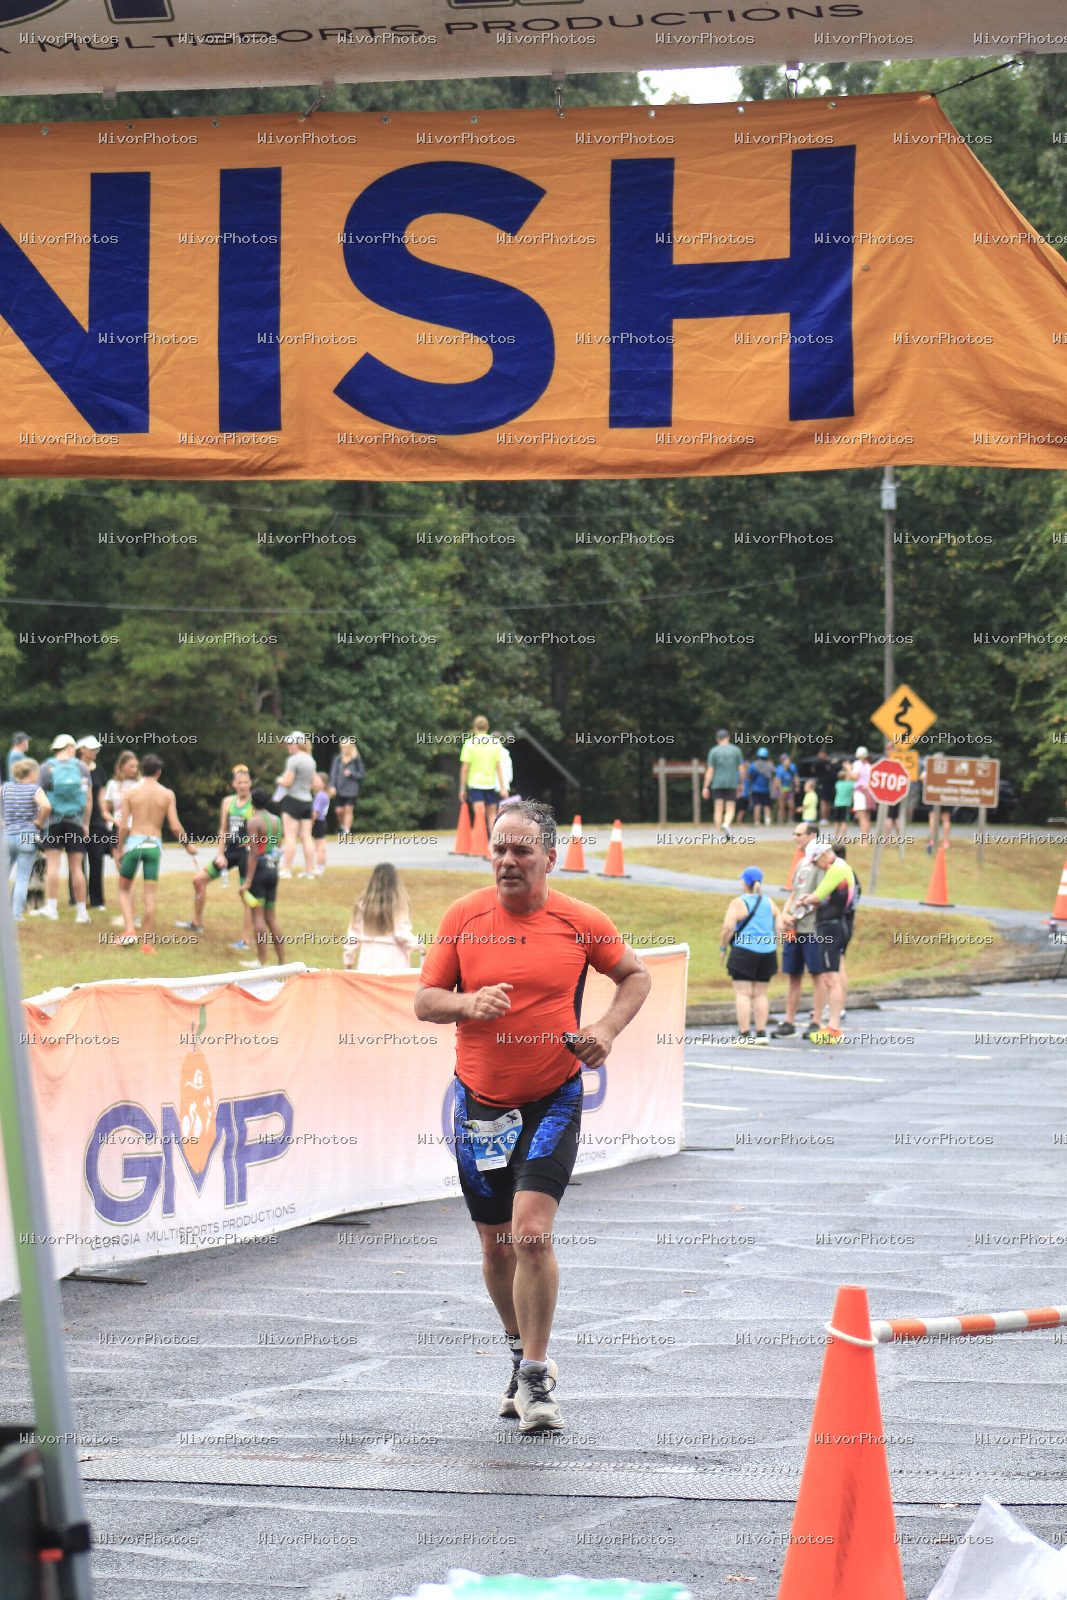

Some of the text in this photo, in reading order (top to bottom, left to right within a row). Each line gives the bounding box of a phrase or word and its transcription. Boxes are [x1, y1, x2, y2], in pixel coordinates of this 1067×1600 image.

[444, 4, 864, 35] PRODUCTIONS
[870, 770, 907, 791] STOP
[85, 1089, 295, 1226] GMP
[146, 1222, 219, 1243] MULTISPORTS
[222, 1203, 296, 1231] PRODUCTIONS
